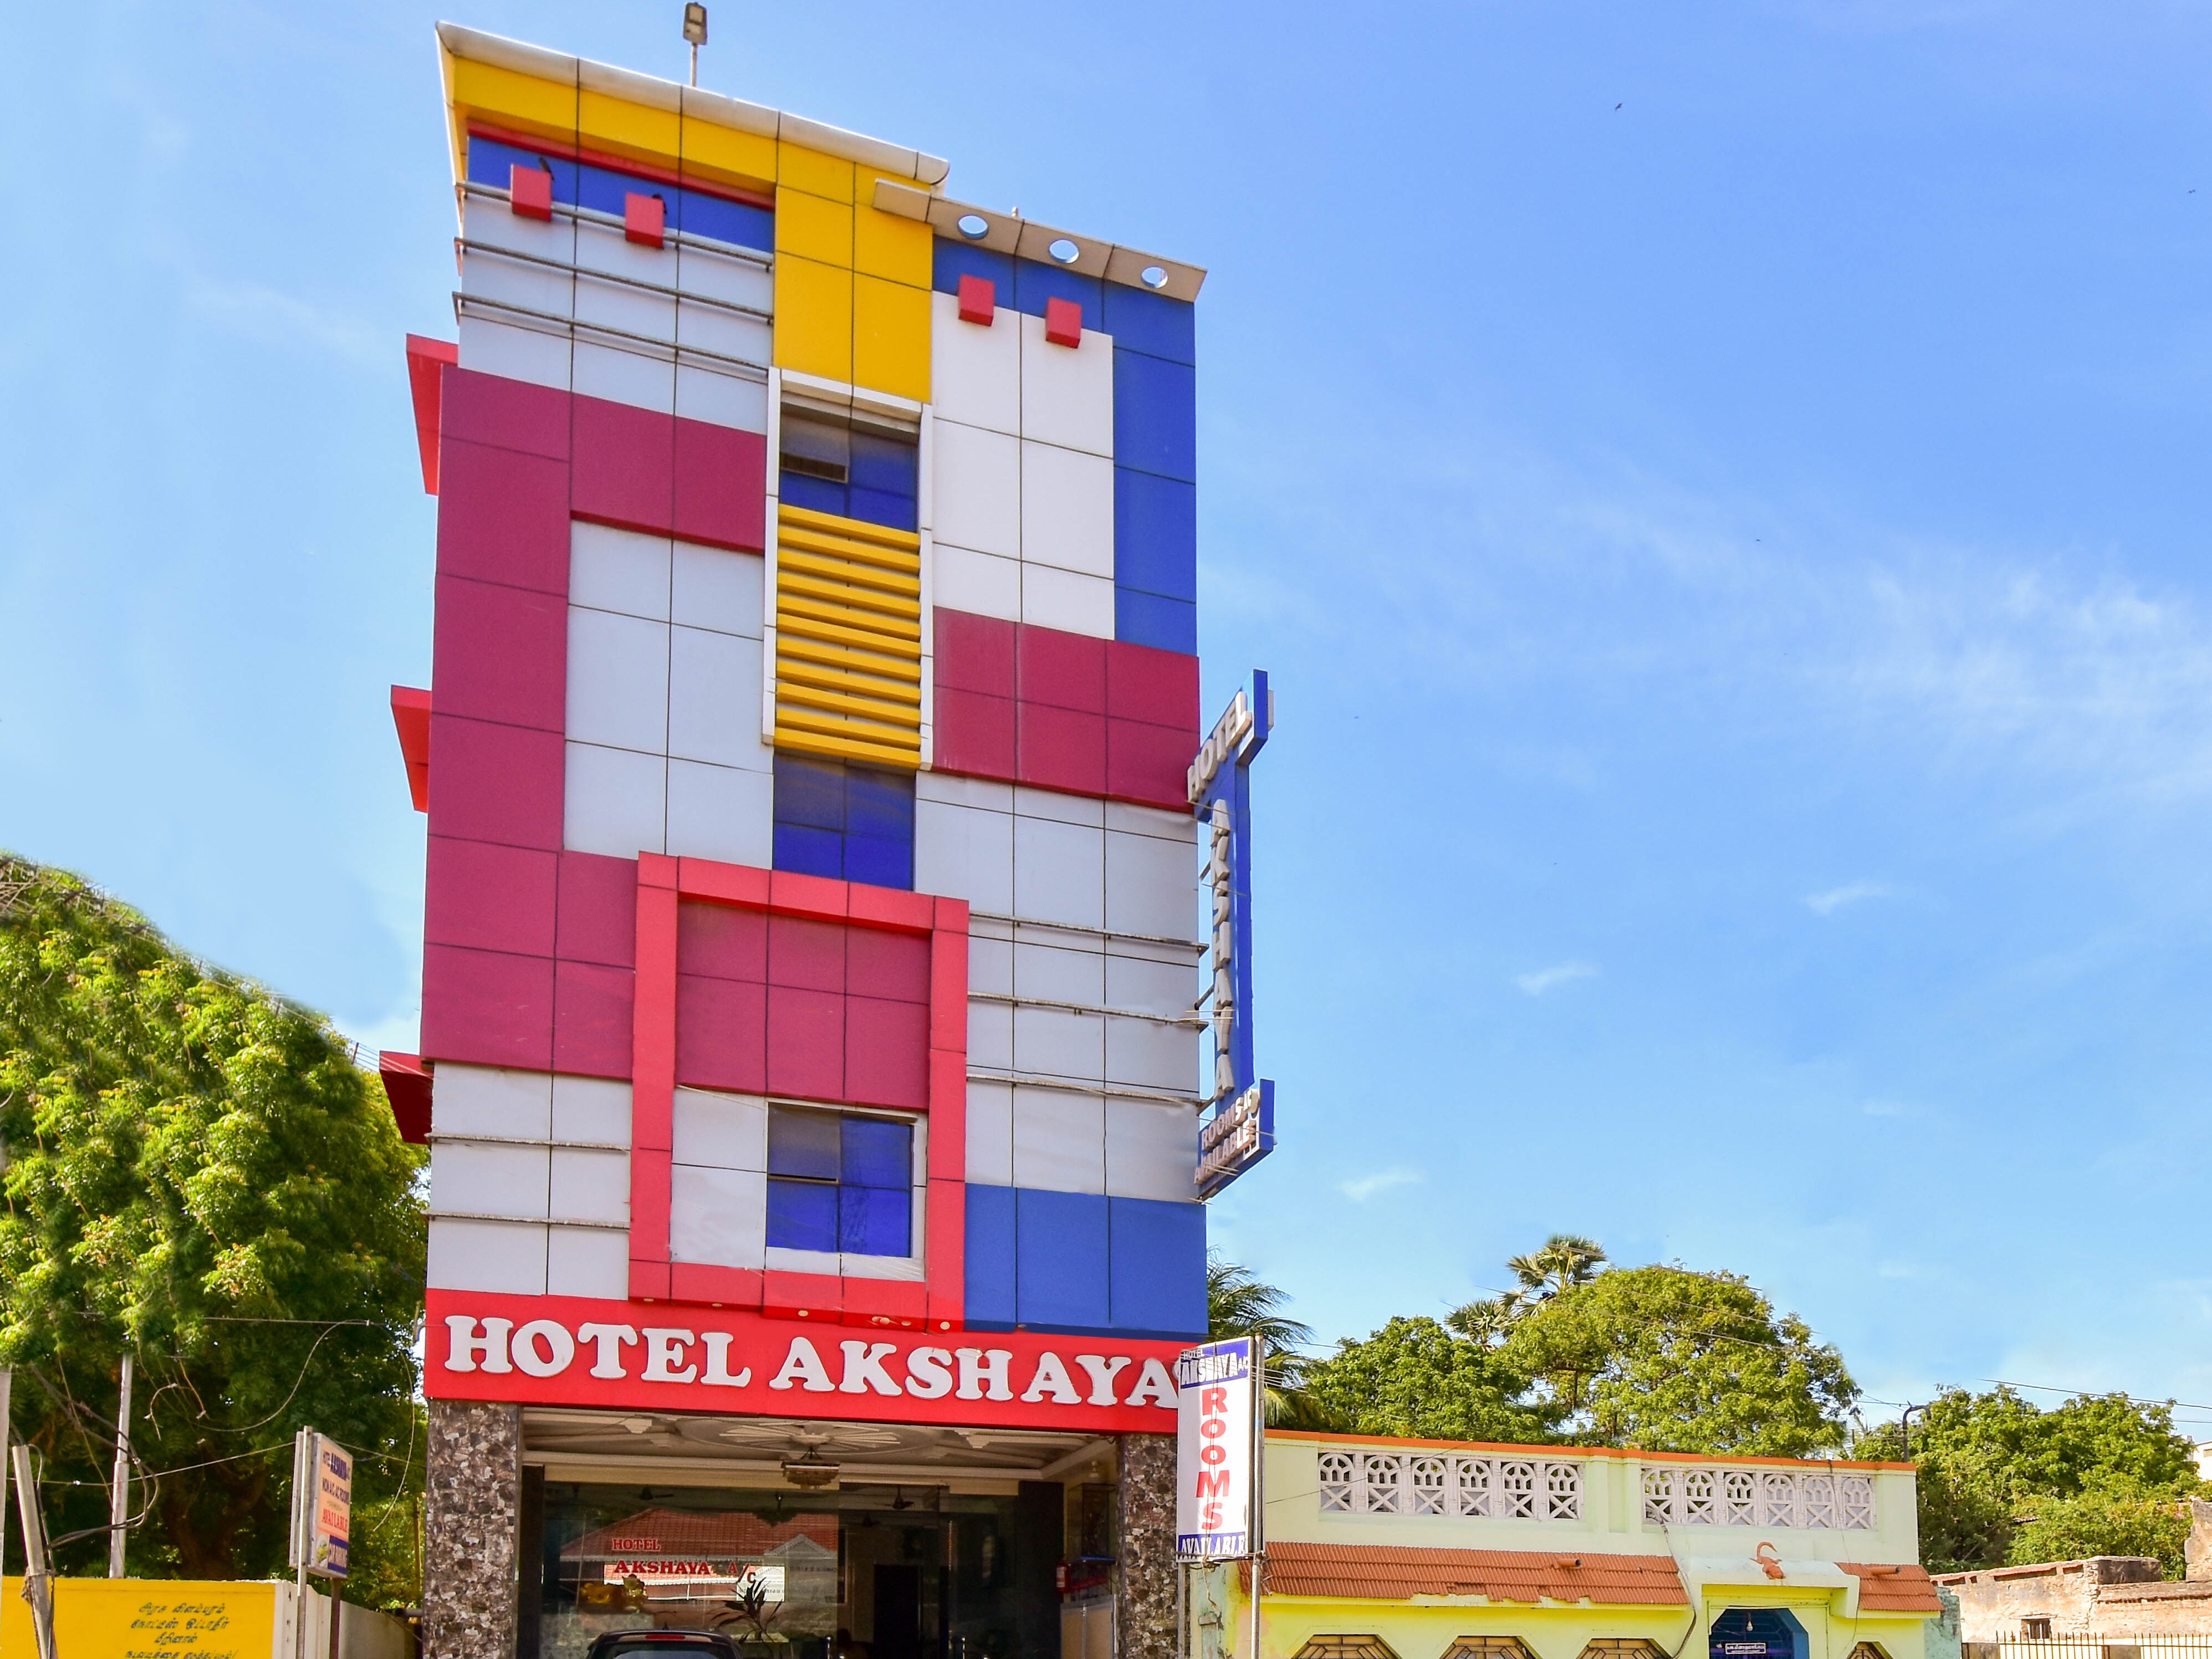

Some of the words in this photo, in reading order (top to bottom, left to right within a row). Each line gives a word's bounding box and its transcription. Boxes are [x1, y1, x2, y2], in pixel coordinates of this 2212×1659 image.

[1187, 691, 1252, 803] HOTEL
[1210, 799, 1235, 1100] AKSHAYA
[1201, 1096, 1247, 1151] ROOMS
[1193, 1119, 1255, 1185] AVAILABLE
[443, 1315, 752, 1389] HOTEL
[768, 1335, 1178, 1410] AKSHAYA
[1181, 1352, 1238, 1385] AKSHAYA
[1183, 1349, 1205, 1360] HOTEL
[1196, 1387, 1230, 1530] ROOMS
[322, 1508, 348, 1533] AVAILABLE
[611, 1538, 661, 1552] HOTEL
[1181, 1535, 1246, 1556] AVAILABLE
[614, 1560, 711, 1575] AKSHAYA
[727, 1561, 756, 1584] A/C
